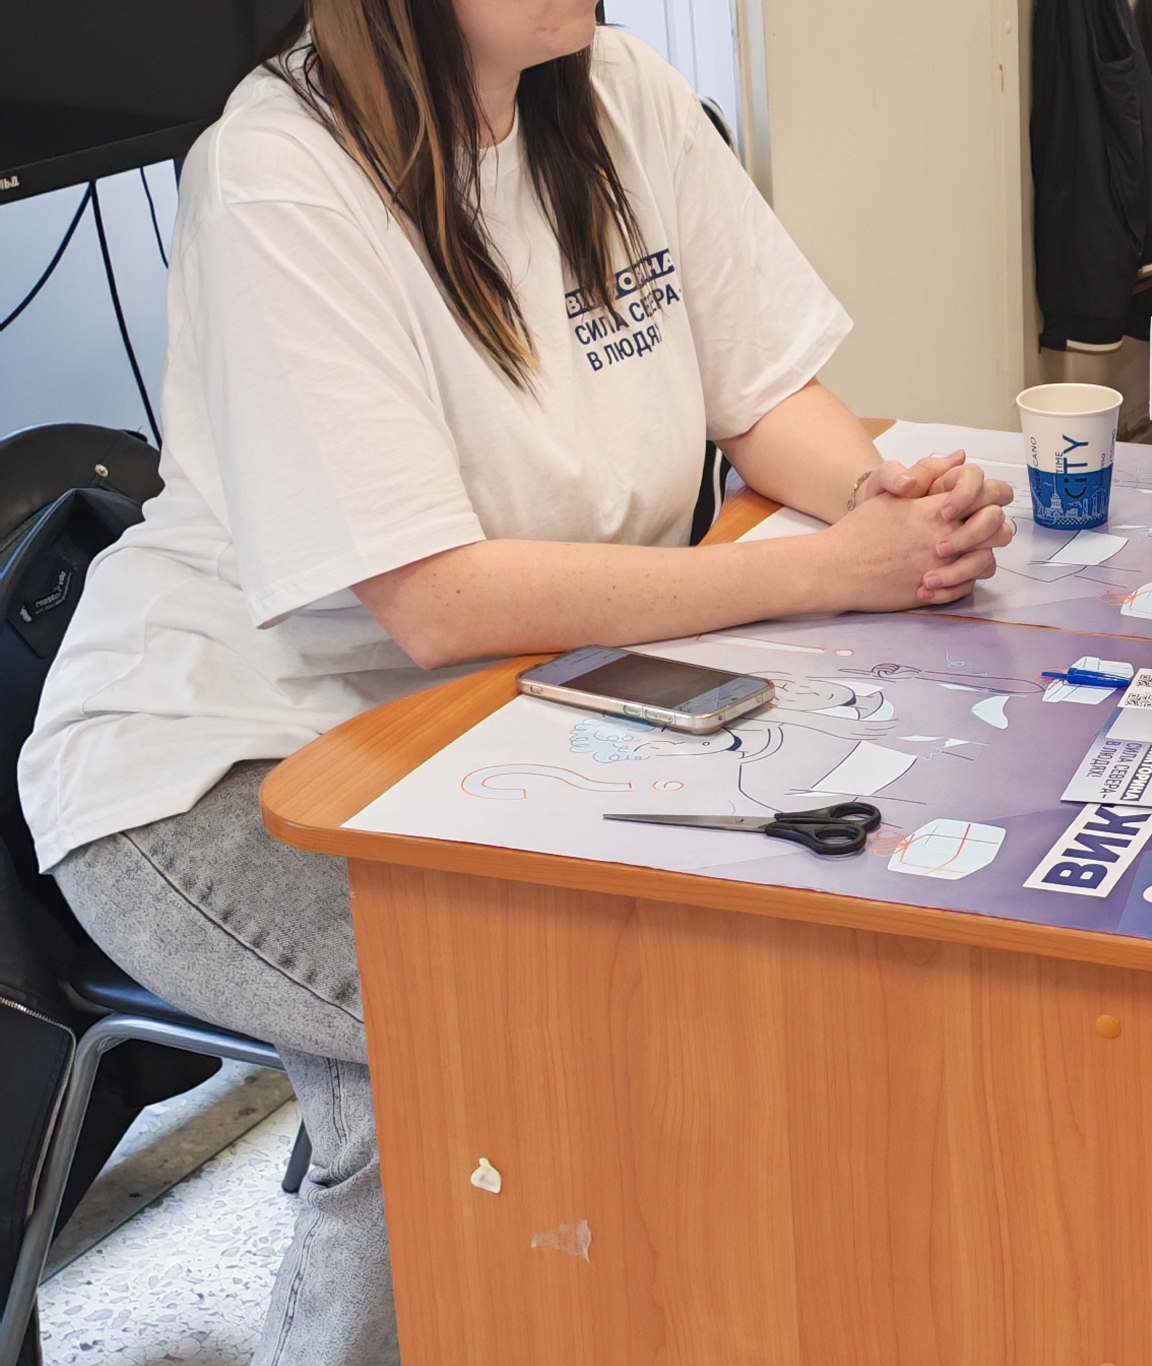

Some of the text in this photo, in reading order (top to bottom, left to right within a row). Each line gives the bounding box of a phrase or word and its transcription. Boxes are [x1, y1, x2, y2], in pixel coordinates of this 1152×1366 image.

[586, 324, 663, 372] В ЛЮДЯ
[1055, 451, 1063, 474] TIME
[1086, 746, 1118, 778] ЛЮДЯХ!
[1117, 742, 1143, 763] СИЛА
